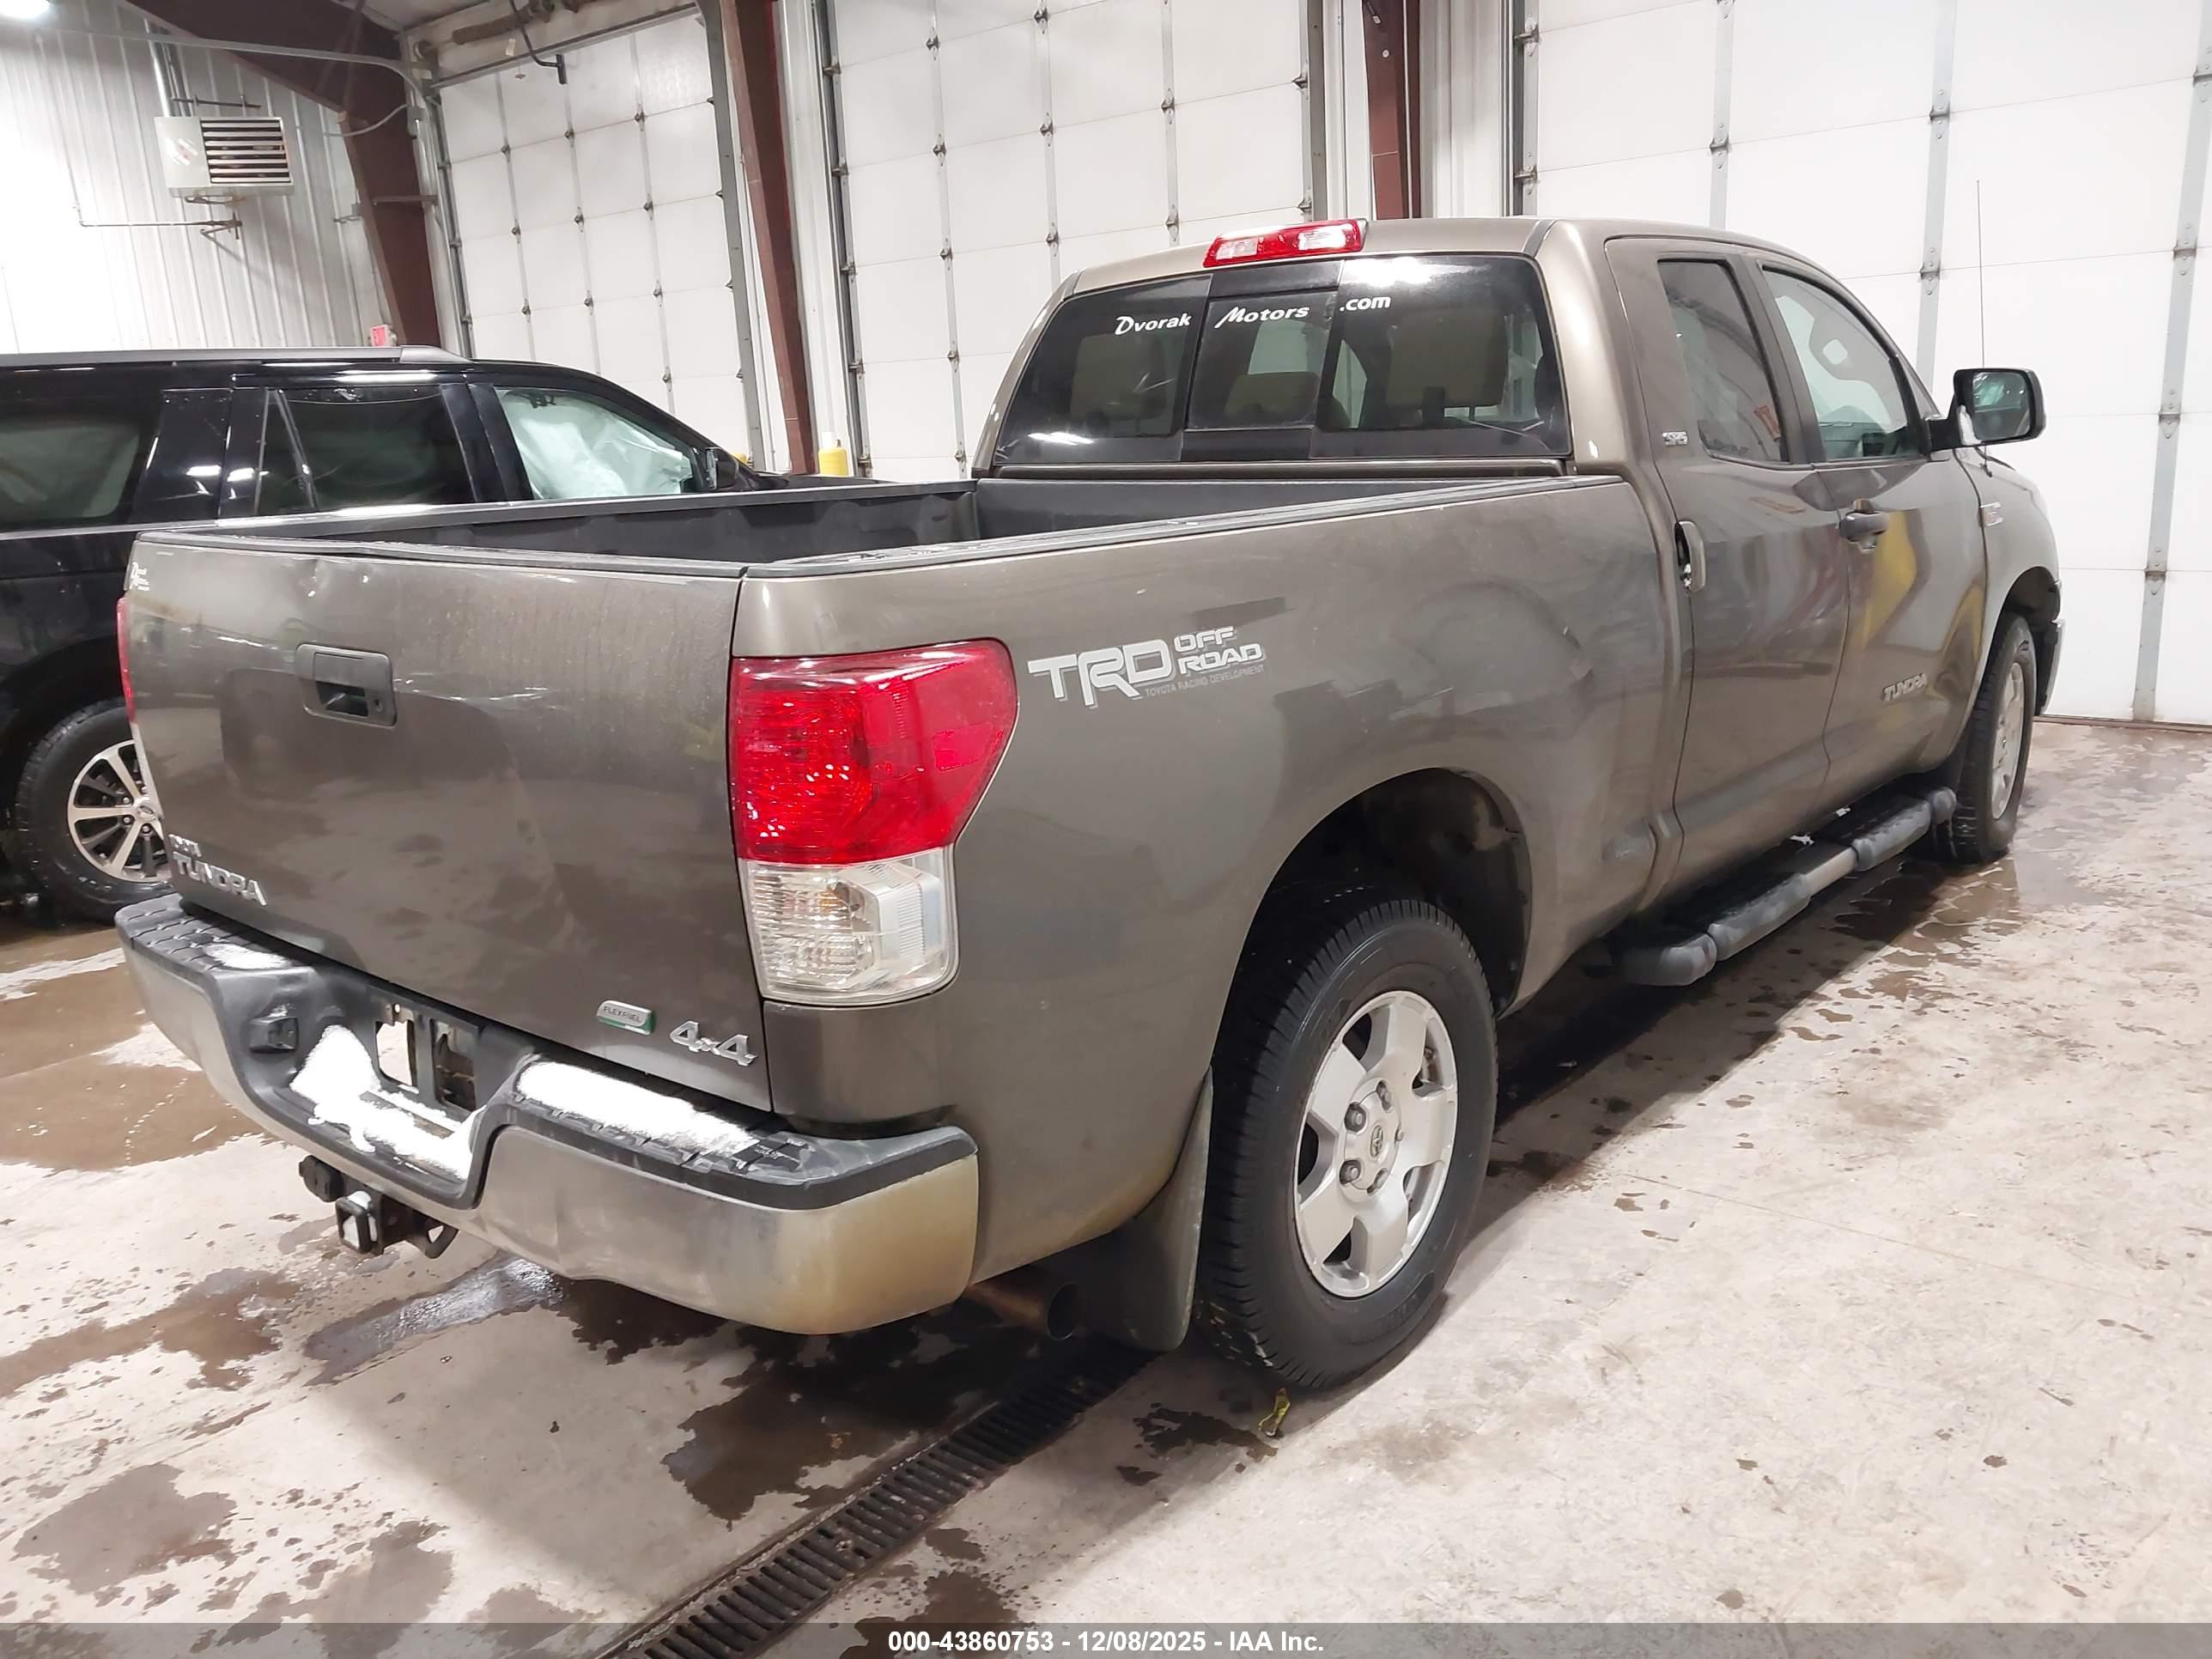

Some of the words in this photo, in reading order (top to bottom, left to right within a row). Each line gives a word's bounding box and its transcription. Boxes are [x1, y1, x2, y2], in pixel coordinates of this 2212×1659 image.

[1115, 313, 1192, 336] Dvorak
[1214, 306, 1310, 329] Motors
[1339, 296, 1392, 313] .com
[1173, 626, 1237, 654] OFF
[1027, 639, 1176, 709] TRD
[1177, 642, 1266, 678] ROAD
[1145, 684, 1177, 698] TOYOTA
[172, 851, 268, 907] TUNDRA
